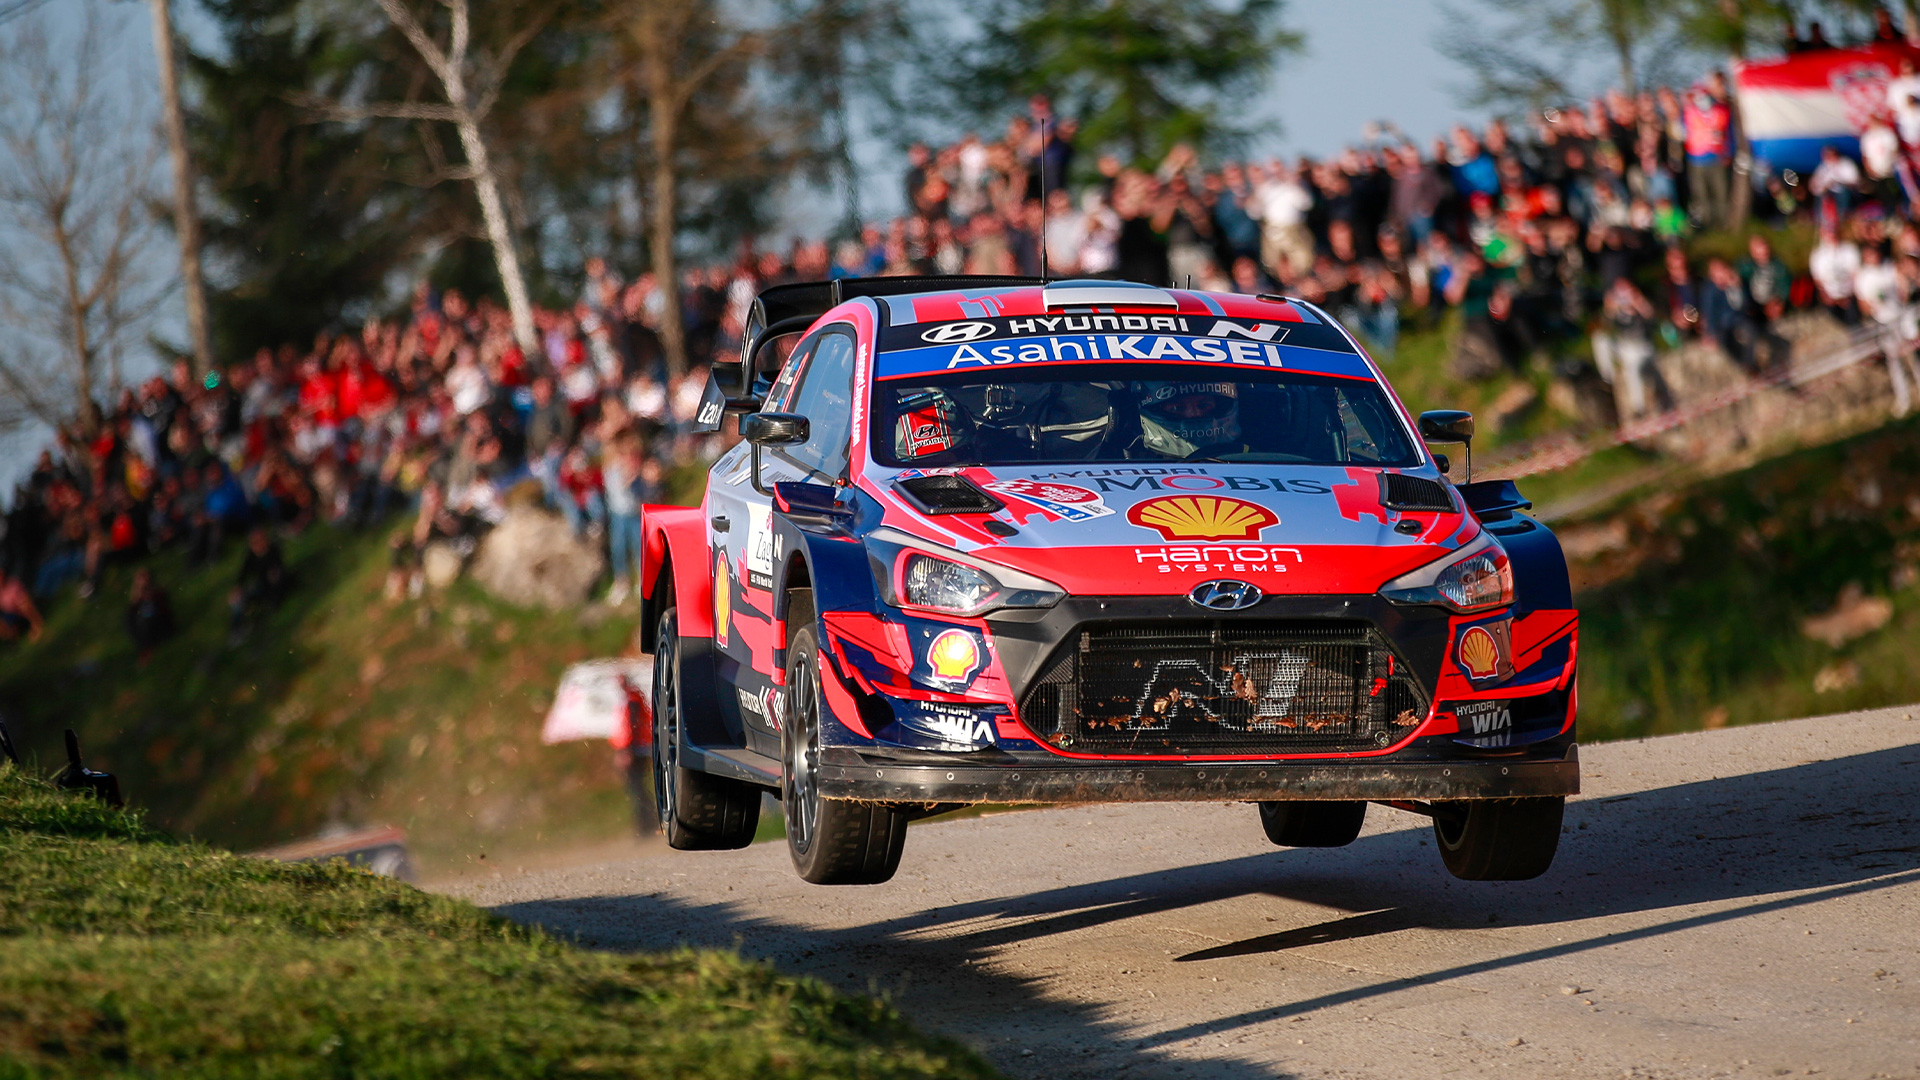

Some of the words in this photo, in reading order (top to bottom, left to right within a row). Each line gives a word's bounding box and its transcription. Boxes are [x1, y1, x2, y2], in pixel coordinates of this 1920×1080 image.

[1008, 315, 1189, 334] HYUNDAI
[946, 336, 1283, 369] AsahiKASEI
[1180, 383, 1231, 394] HYUNDAI
[1172, 426, 1226, 438] caroom
[1030, 467, 1208, 480] HYUNDAI
[1096, 475, 1332, 495] MOBIS
[1157, 564, 1287, 573] SYSTEMS
[920, 700, 971, 717] HYUNDAI
[1456, 700, 1496, 717] HYUNDAI
[1471, 706, 1512, 735] WIA
